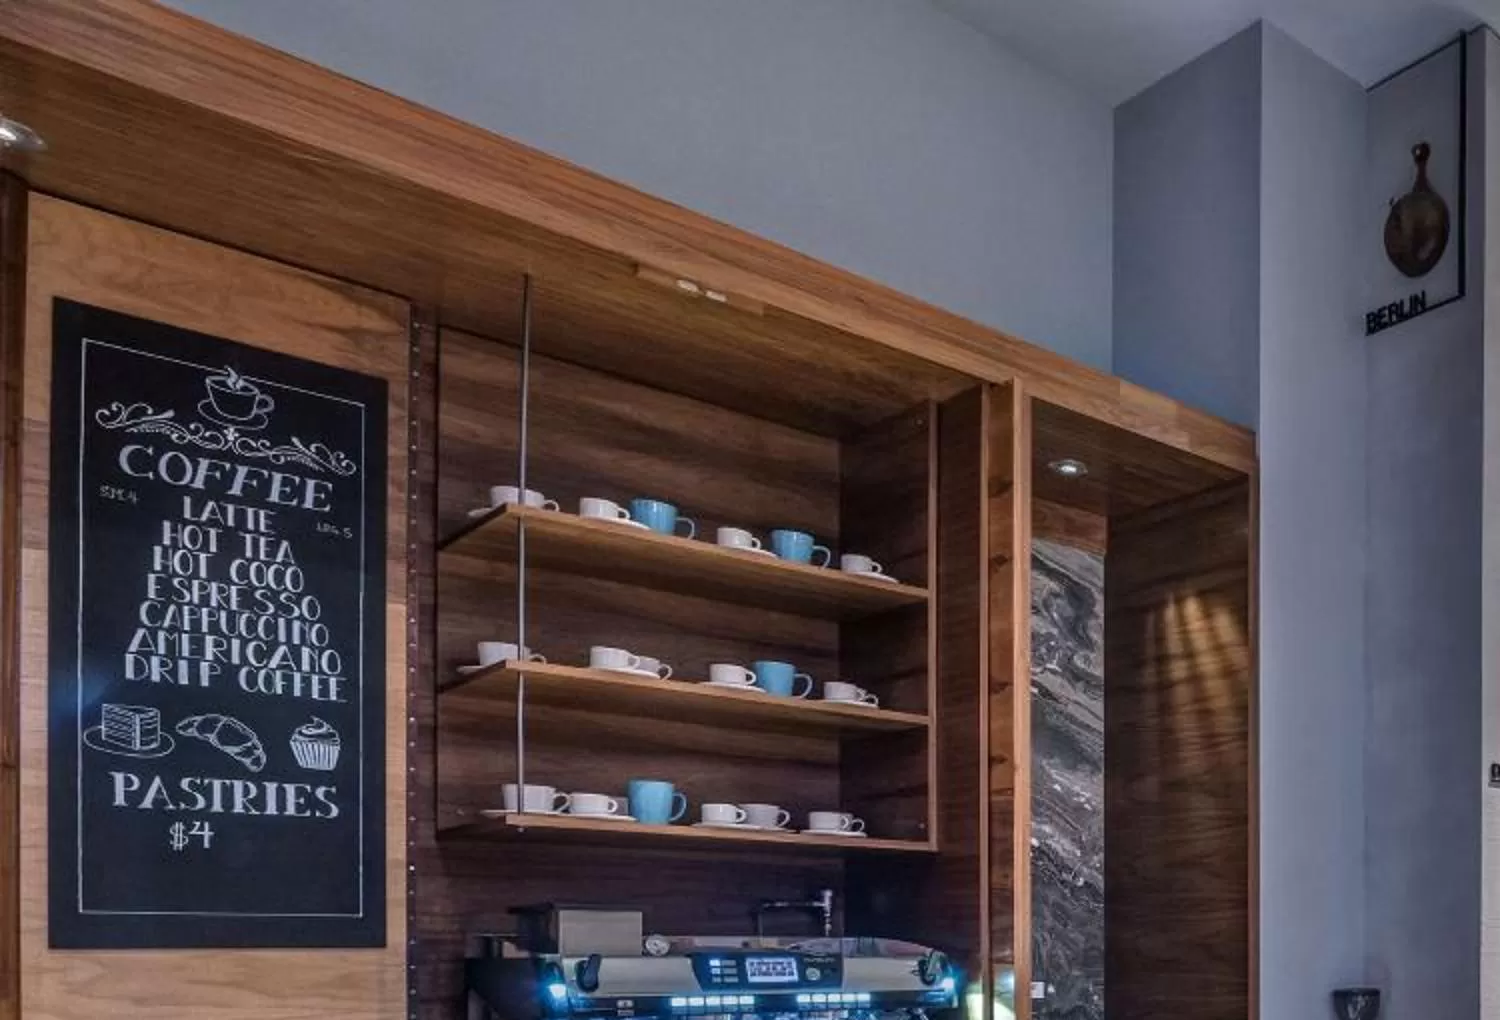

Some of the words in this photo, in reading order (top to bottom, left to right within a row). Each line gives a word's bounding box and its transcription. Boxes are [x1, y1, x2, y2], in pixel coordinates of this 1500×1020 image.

[1365, 290, 1427, 336] BERLIN
[118, 444, 334, 512] COFFEE
[183, 496, 277, 534] LATTE
[162, 519, 223, 553] HOT
[238, 531, 296, 565] TEA
[152, 545, 213, 579] HOT
[229, 558, 304, 593] COCO
[147, 573, 321, 621] ESPRESSO
[139, 600, 329, 648] CAPPUCCINO
[127, 627, 342, 675] AMERICANO
[124, 653, 222, 688] DRIP
[238, 665, 348, 702] COFFEE
[108, 771, 340, 819] PASTRIES
[169, 821, 215, 851] $4
